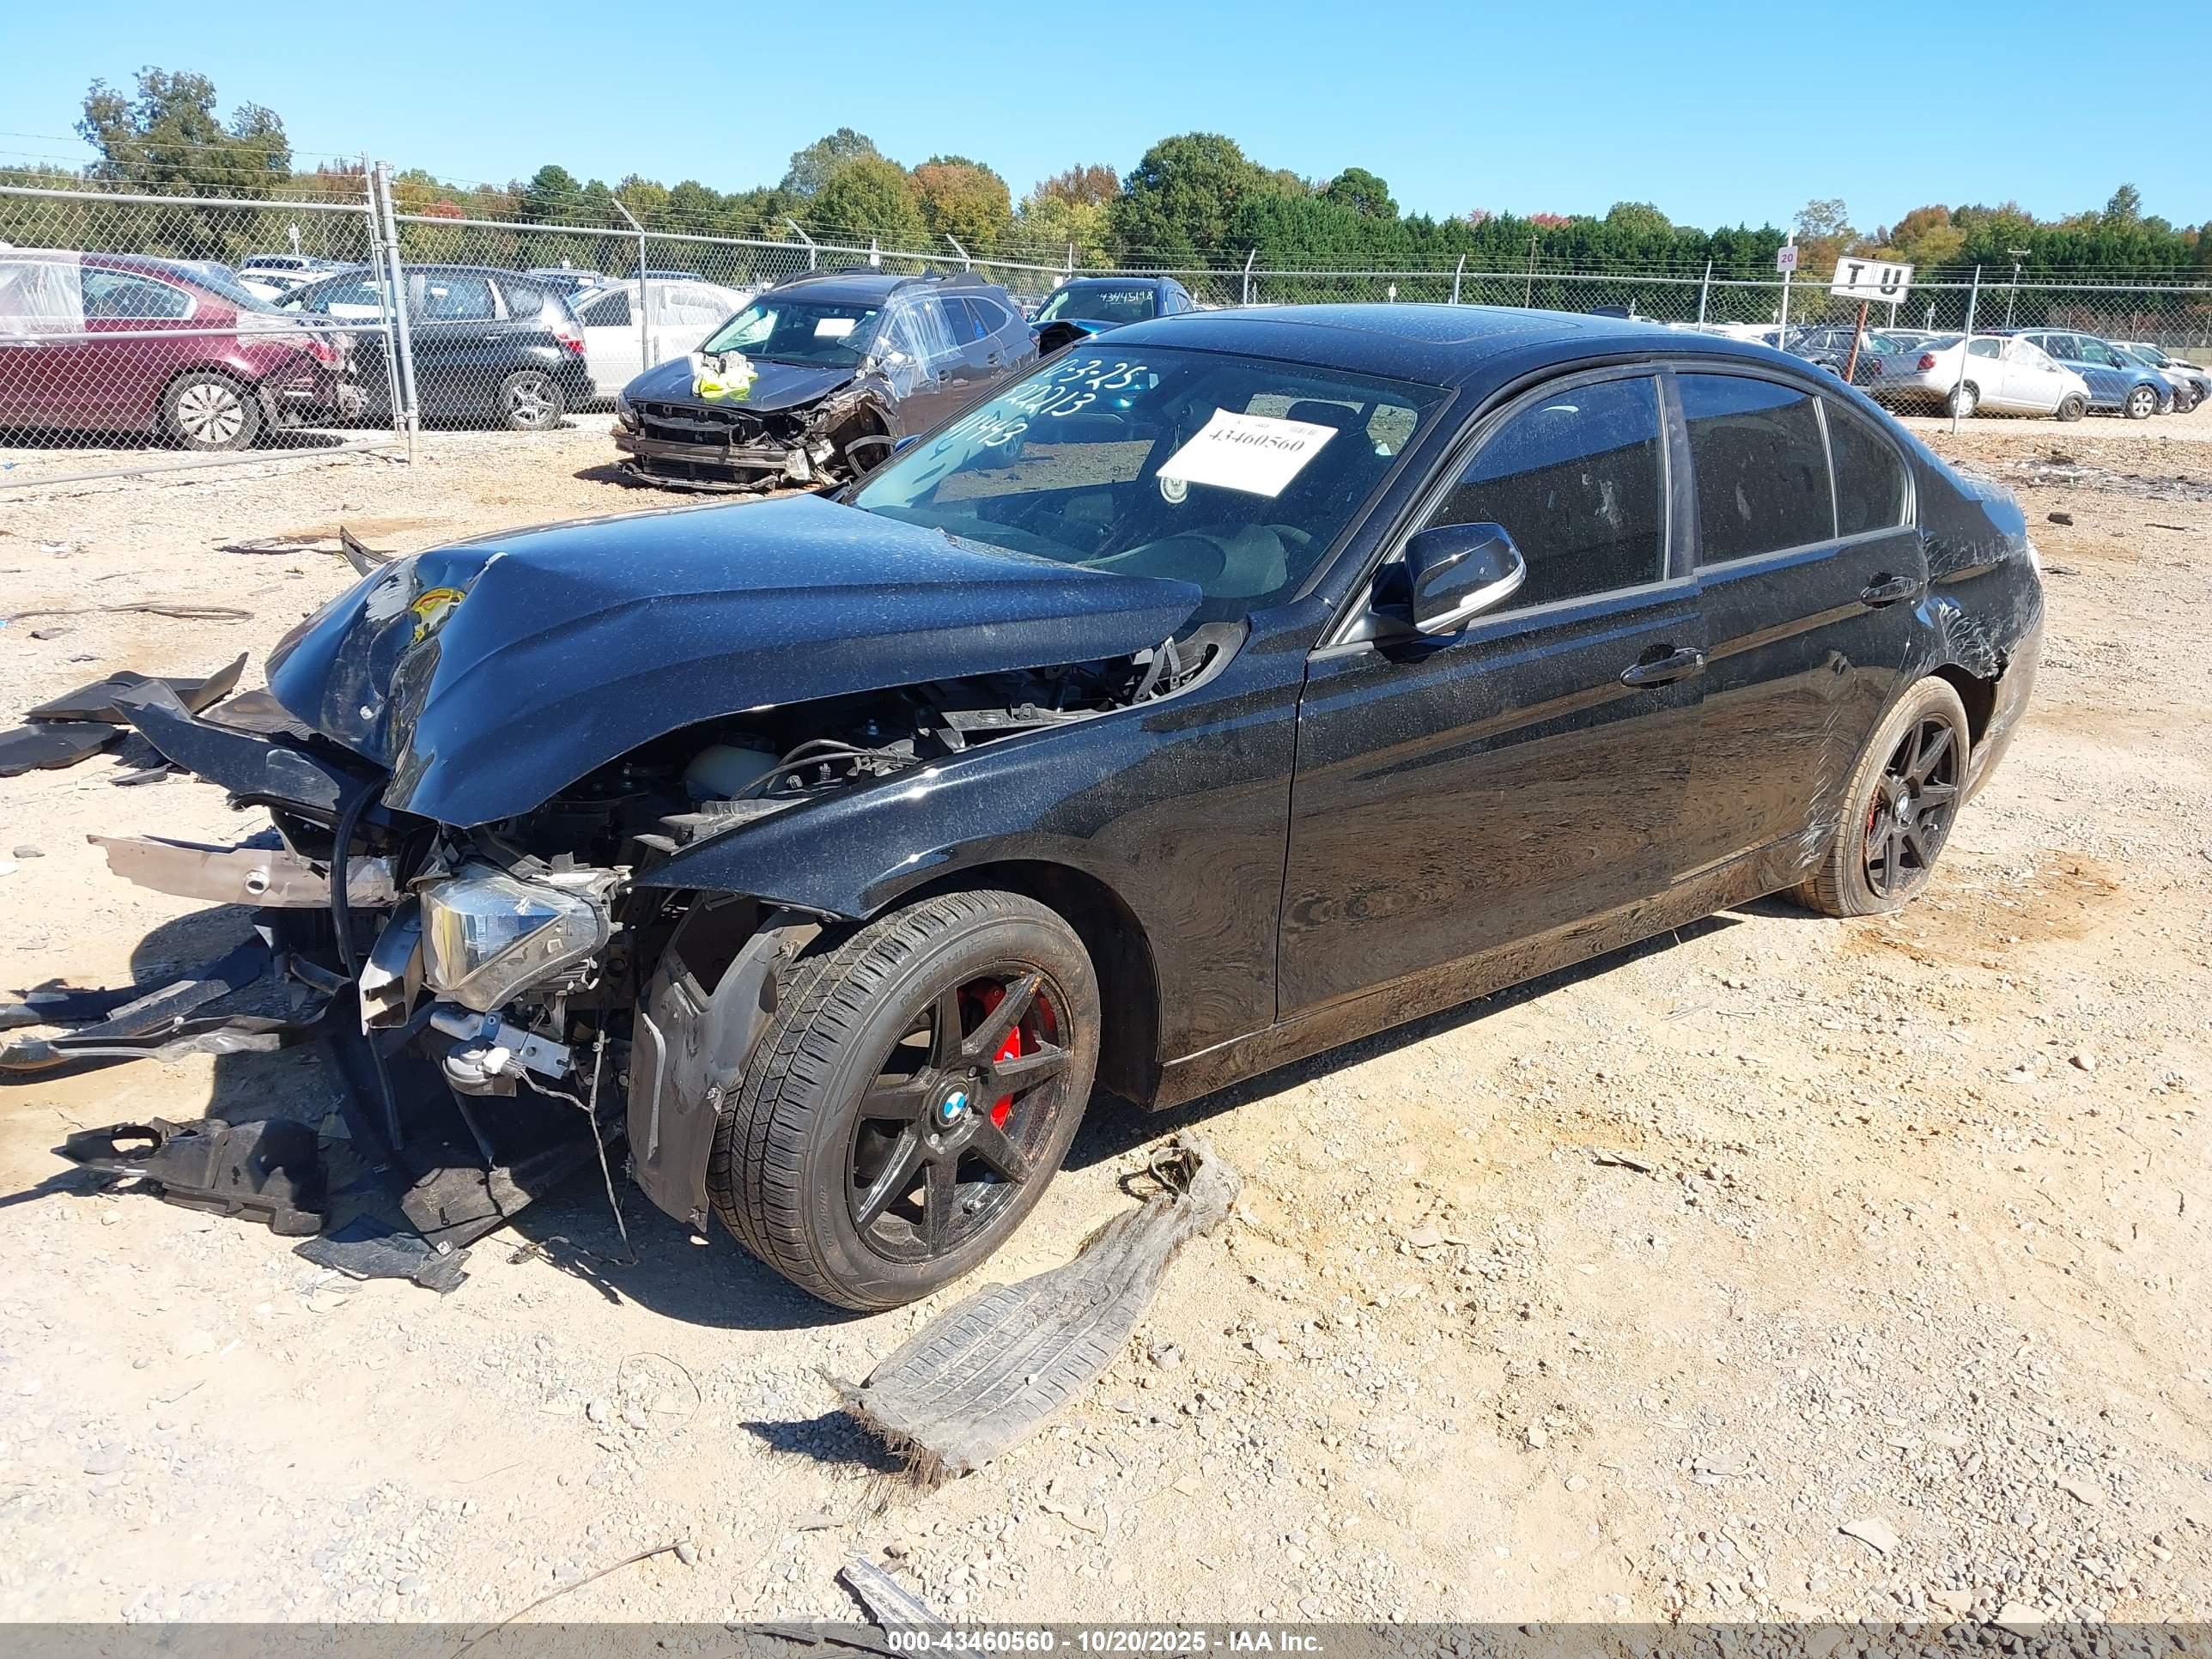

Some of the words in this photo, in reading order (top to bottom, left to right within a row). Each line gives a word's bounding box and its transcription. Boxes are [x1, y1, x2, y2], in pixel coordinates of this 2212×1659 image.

[1782, 254, 1793, 263] 20
[1848, 263, 1864, 289] T
[1880, 268, 1902, 295] U
[1042, 359, 1147, 390] 10-3-25
[992, 383, 1097, 416] 522213
[1209, 429, 1304, 452] 43460560
